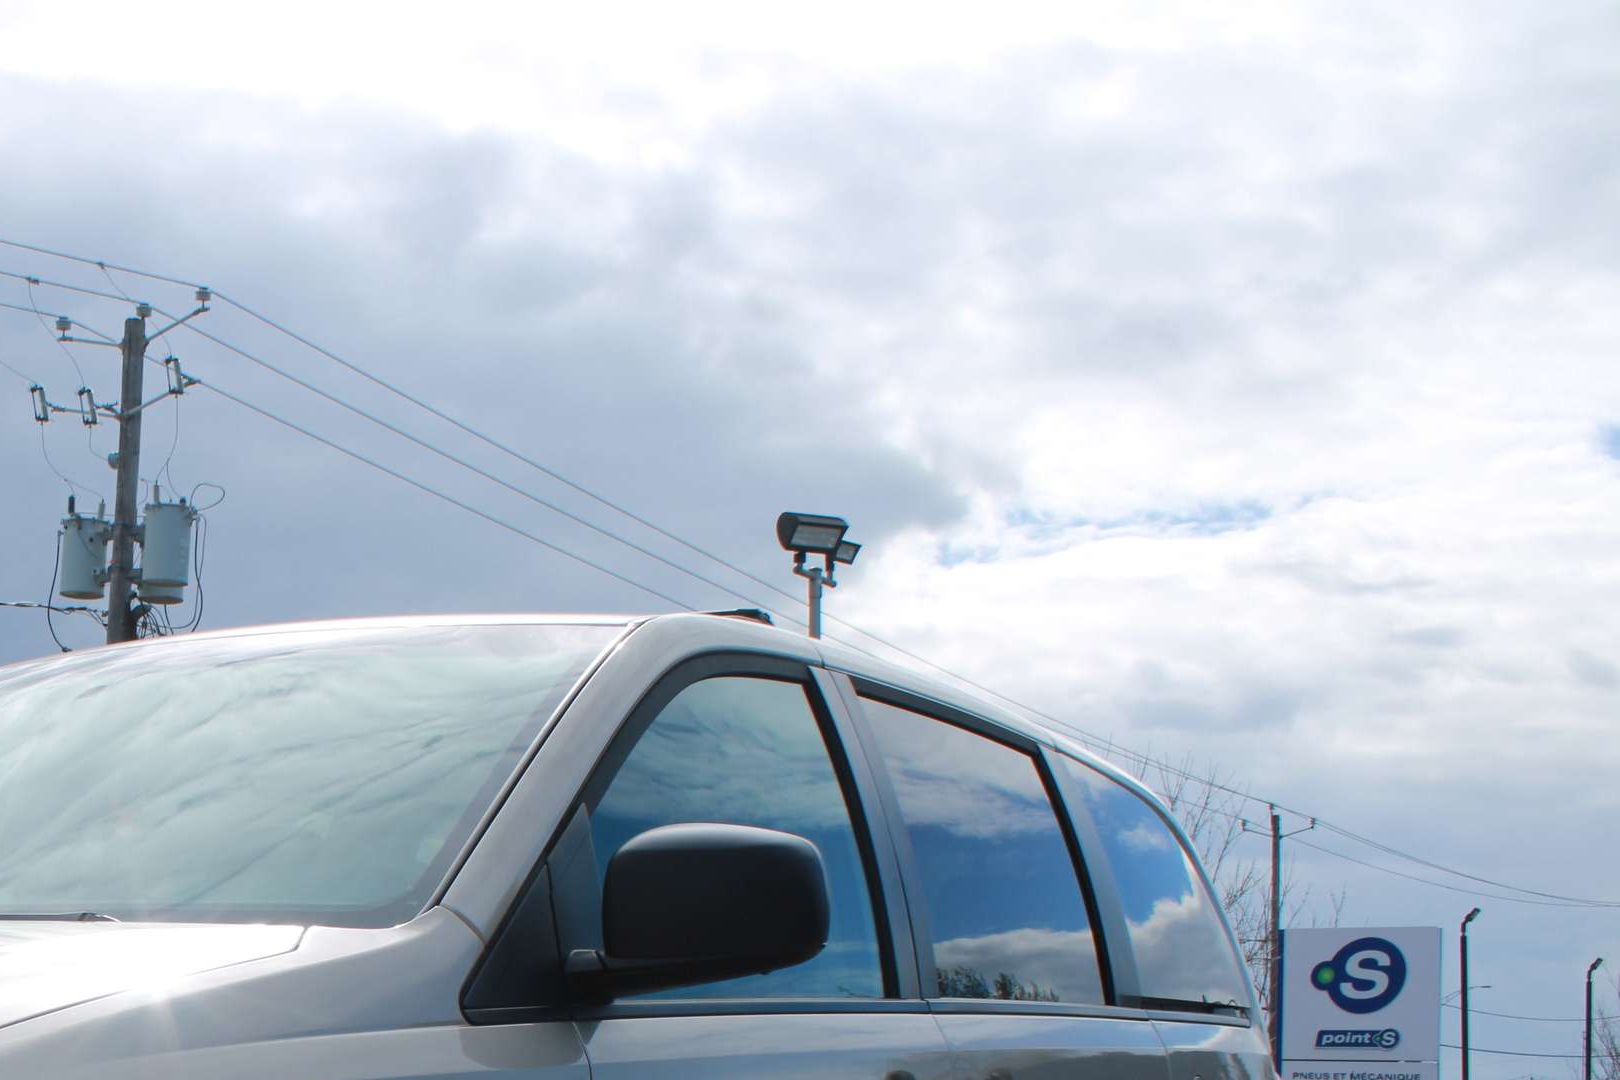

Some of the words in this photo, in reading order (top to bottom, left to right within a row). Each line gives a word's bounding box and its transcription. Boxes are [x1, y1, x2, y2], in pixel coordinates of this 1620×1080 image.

[1322, 1032, 1371, 1046] point
[1381, 1031, 1396, 1045] S
[1292, 1072, 1329, 1080] PNEUS
[1333, 1072, 1347, 1080] ET
